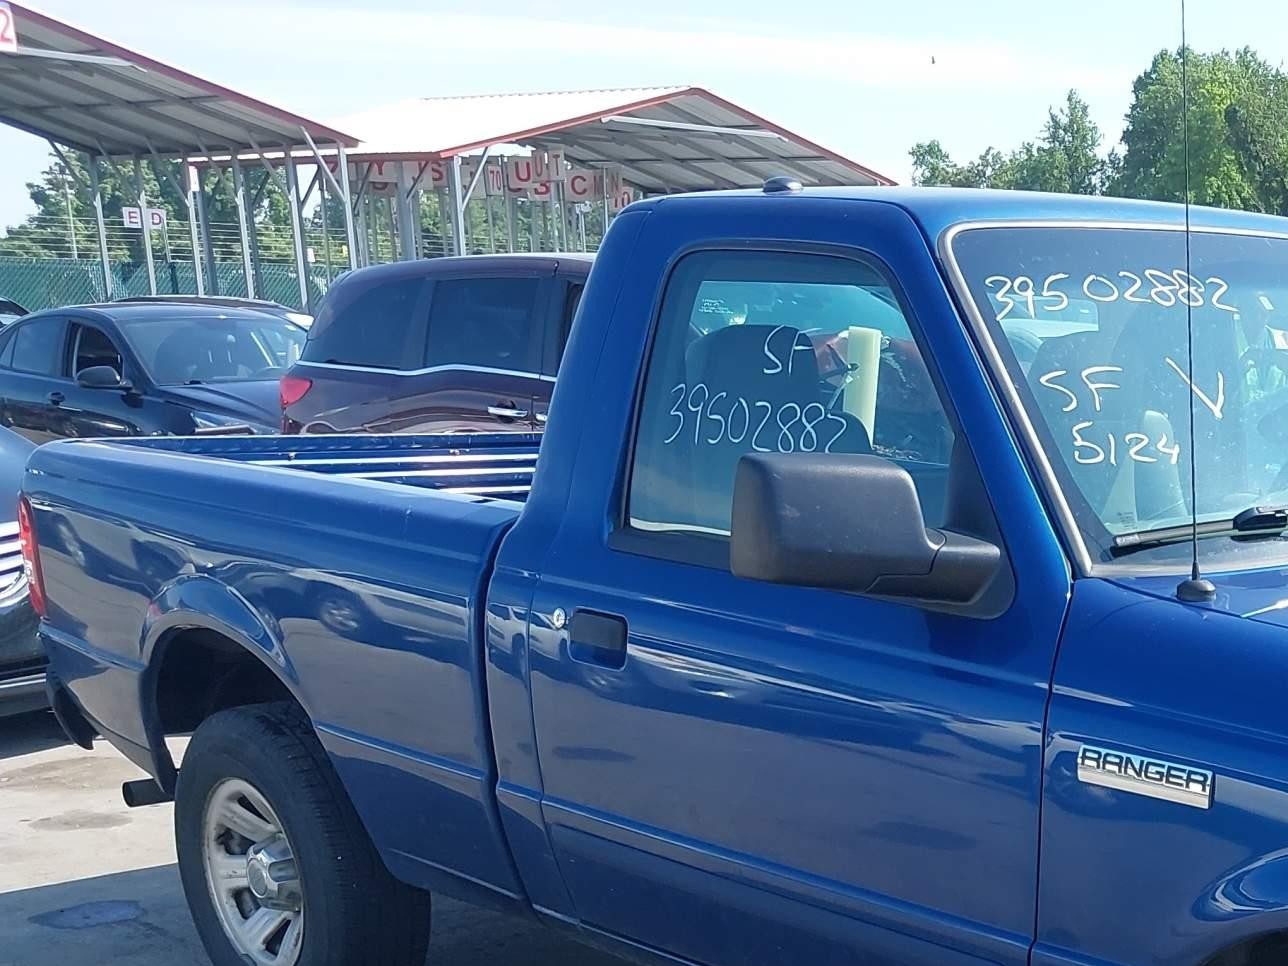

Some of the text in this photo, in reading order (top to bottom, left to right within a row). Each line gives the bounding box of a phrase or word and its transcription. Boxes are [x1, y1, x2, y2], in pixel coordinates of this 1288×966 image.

[571, 175, 588, 195] C
[128, 211, 138, 224] E
[151, 212, 162, 225] D
[984, 268, 1240, 321] 39502882
[763, 325, 822, 376] SF
[1039, 366, 1123, 412] SF
[1080, 748, 1209, 793] RANGER
